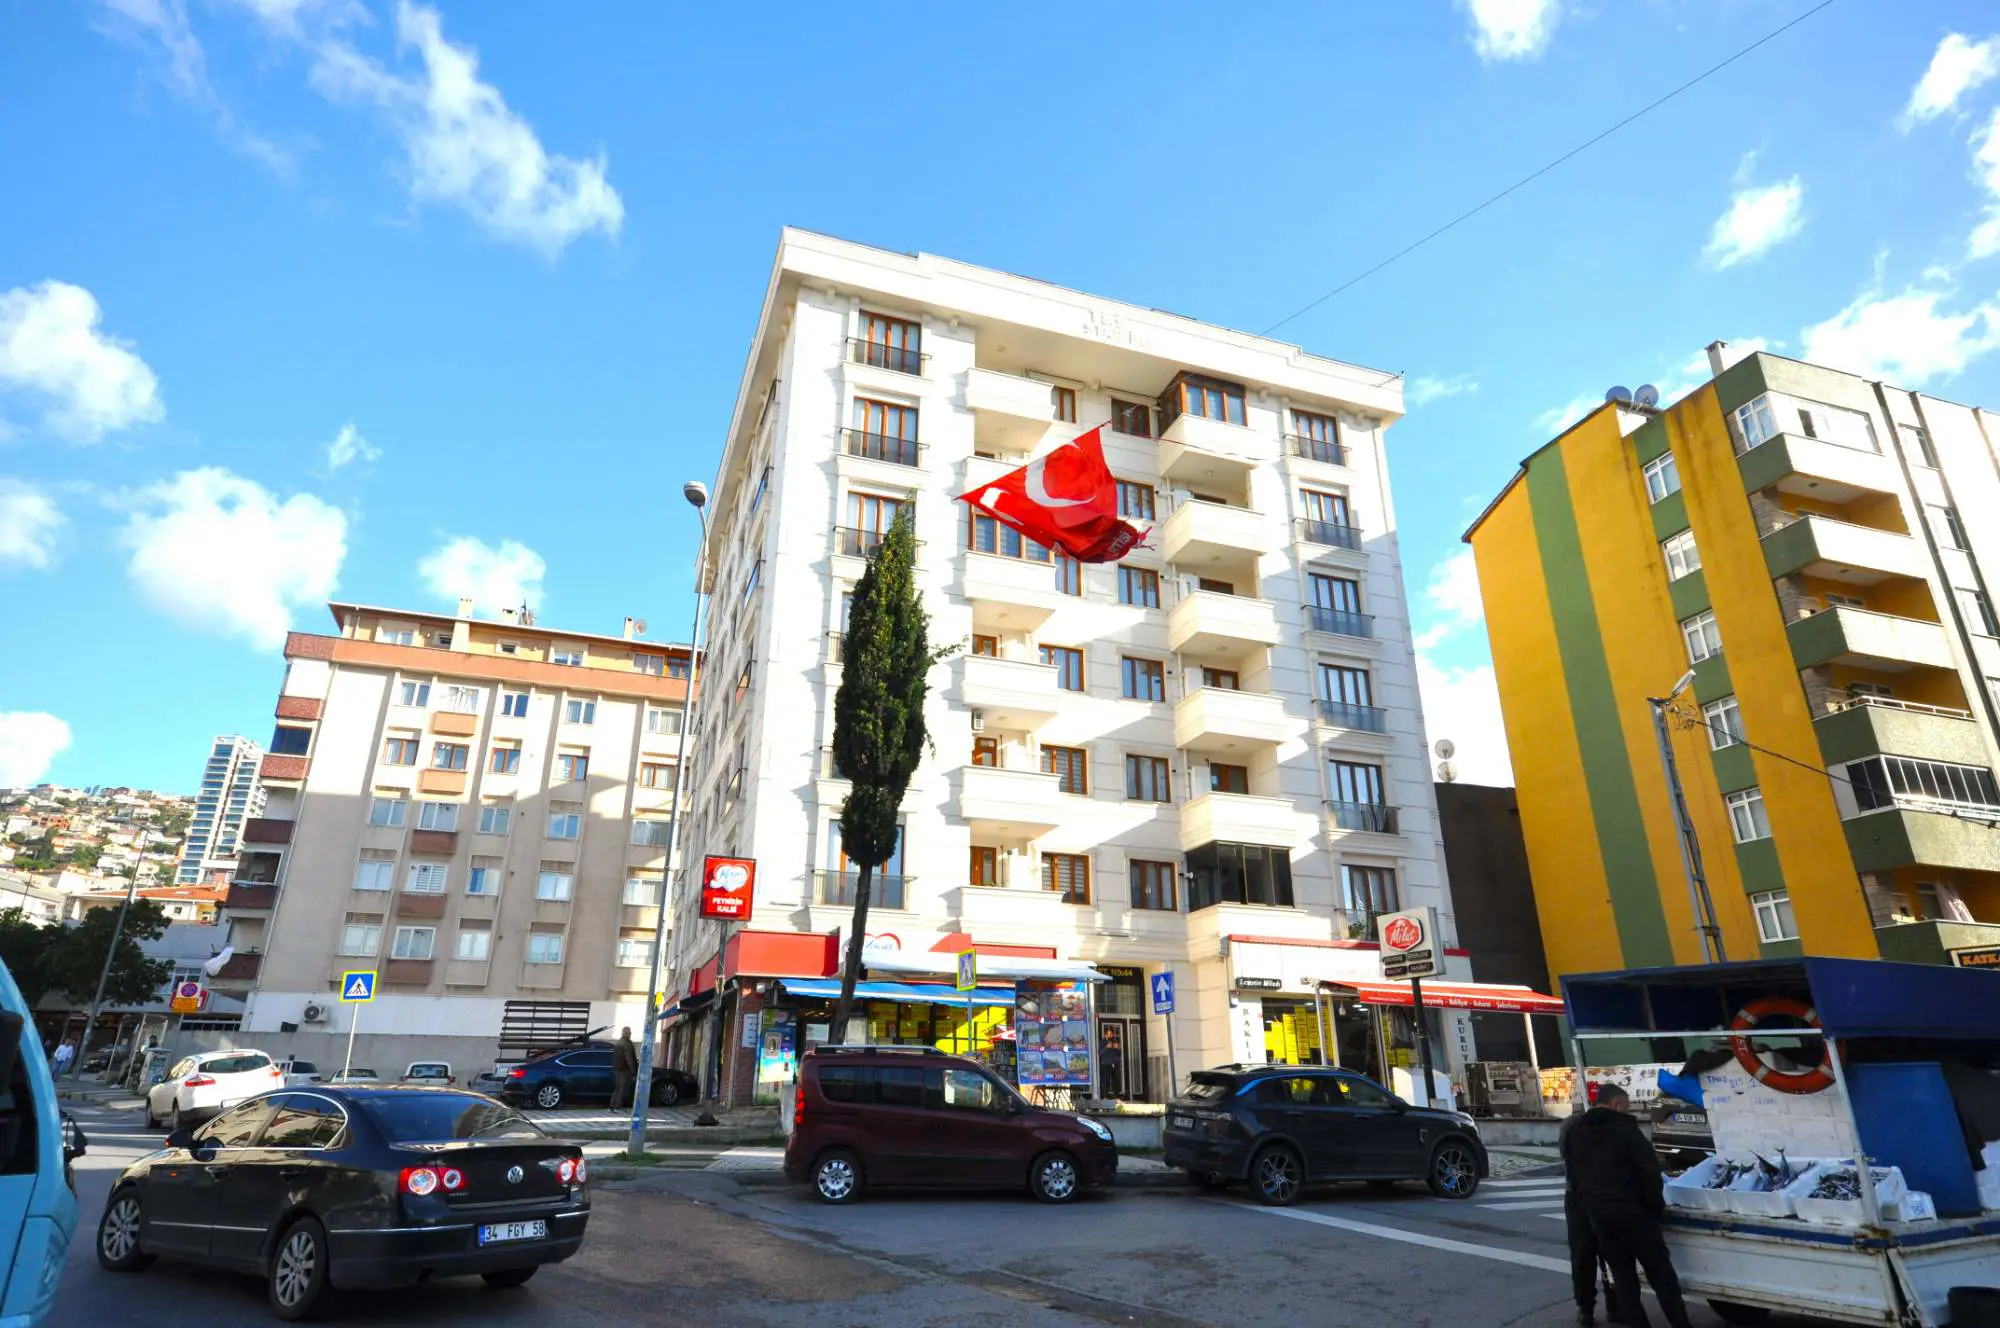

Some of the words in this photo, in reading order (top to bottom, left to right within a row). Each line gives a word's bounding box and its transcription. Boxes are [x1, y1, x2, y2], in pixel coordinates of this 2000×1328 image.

[485, 1226, 498, 1240] 34
[507, 1223, 526, 1238] FGY
[532, 1222, 544, 1235] 58
